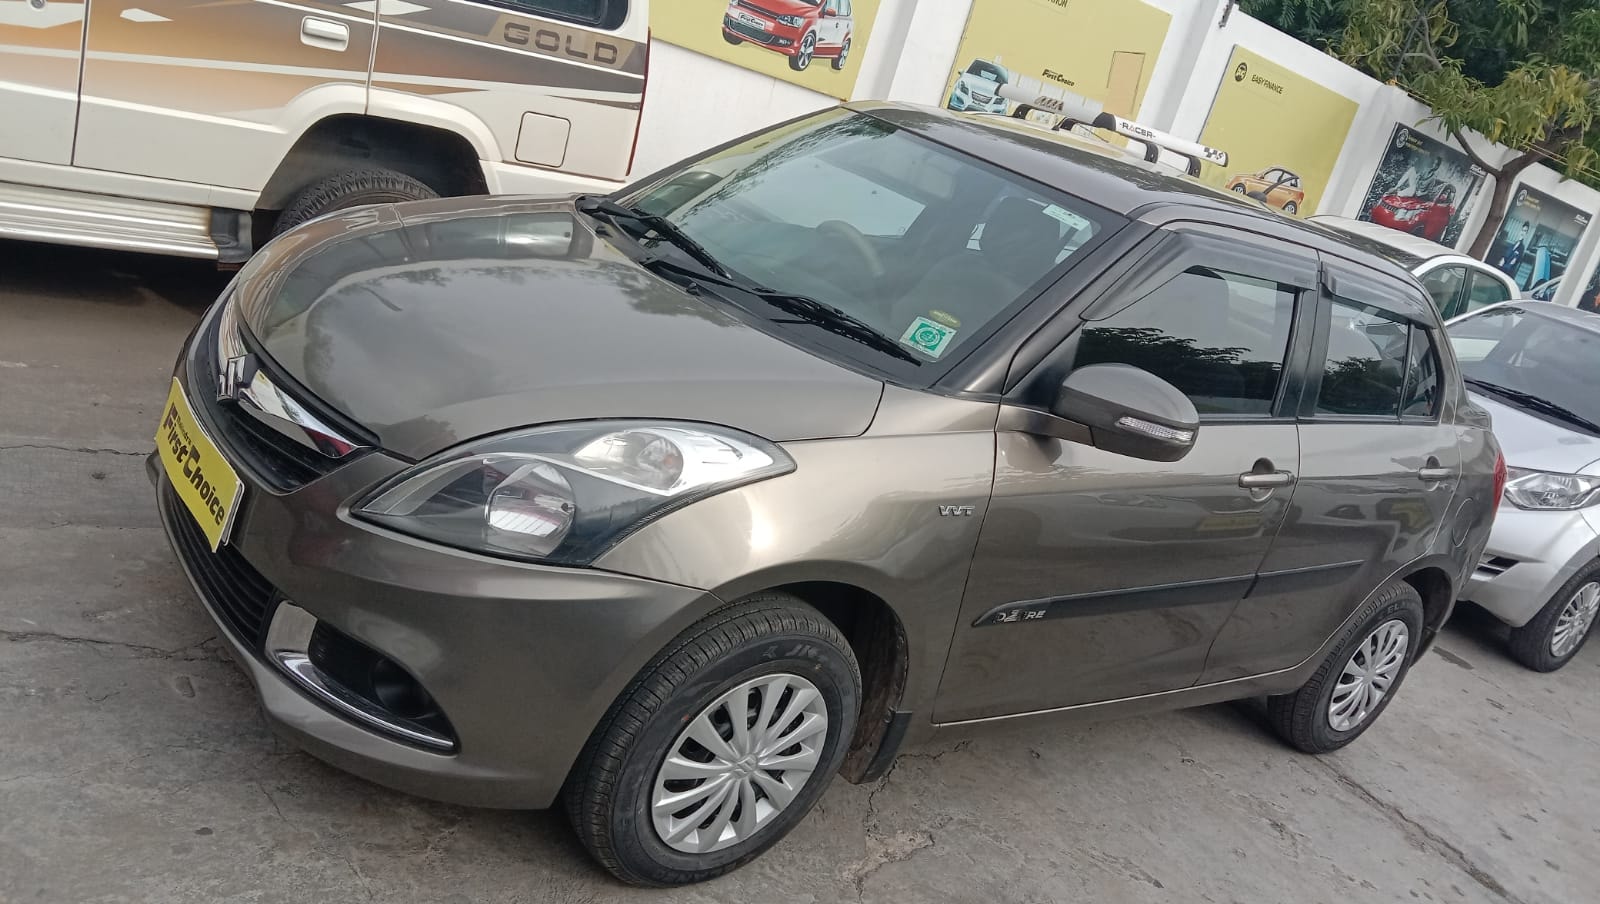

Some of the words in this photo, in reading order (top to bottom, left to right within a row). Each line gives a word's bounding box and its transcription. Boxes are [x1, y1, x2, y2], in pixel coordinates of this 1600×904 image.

[504, 22, 618, 65] GOLD
[1251, 74, 1264, 85] EASY
[1263, 80, 1284, 94] FINANCE
[163, 402, 189, 464] First
[183, 445, 226, 526] Choice
[938, 505, 976, 517] VVT
